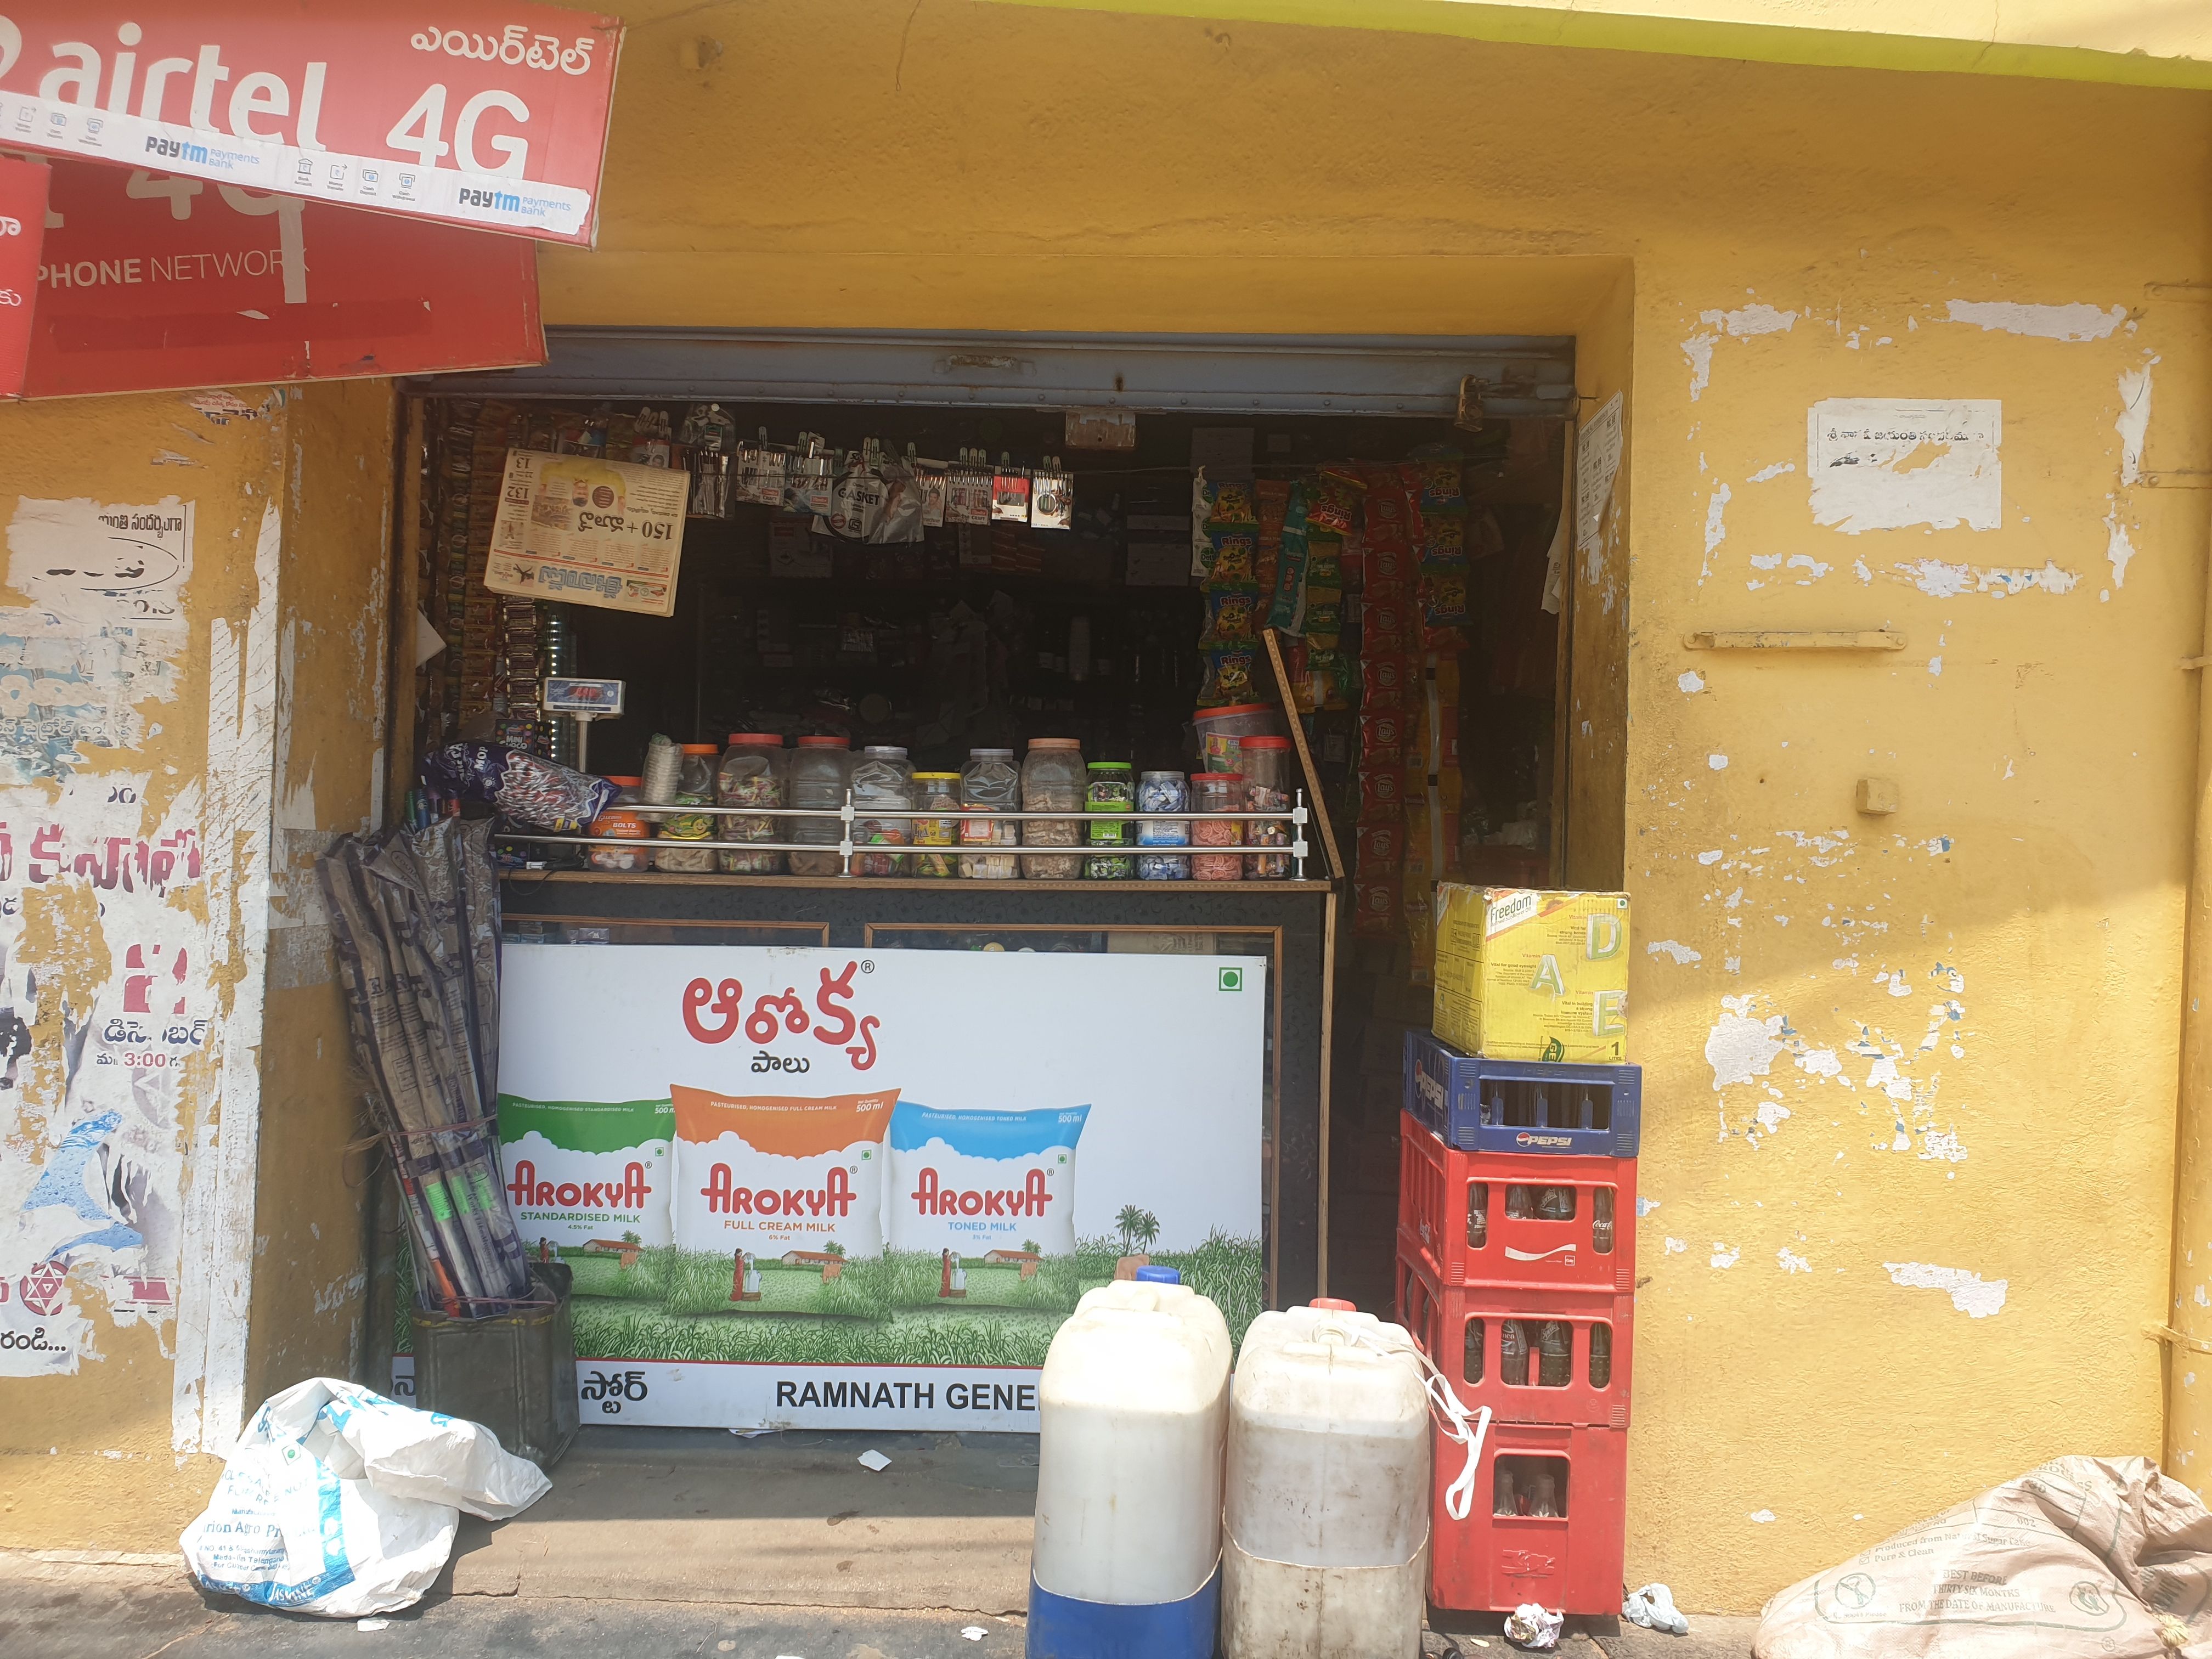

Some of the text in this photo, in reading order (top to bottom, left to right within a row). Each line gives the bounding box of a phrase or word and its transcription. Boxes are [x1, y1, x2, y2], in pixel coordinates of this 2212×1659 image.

[38, 22, 327, 152] airtel
[386, 83, 530, 179] 4G
[211, 149, 259, 164] Payments
[209, 159, 234, 170] Bank
[521, 206, 545, 217] Bank
[523, 197, 571, 211] Payments
[151, 248, 311, 281] NETWOR
[838, 487, 880, 506] GASKET
[642, 521, 674, 540] 150
[1221, 537, 1252, 546] Rings
[1221, 597, 1251, 607] Rings
[1221, 655, 1251, 665] Rings
[506, 735, 523, 743] MINI
[1489, 894, 1532, 923] Freedom
[1586, 913, 1622, 961] D
[1530, 953, 1565, 996] A
[682, 961, 881, 1071] ఆరోక్య
[1593, 989, 1627, 1036] E
[1611, 1041, 1620, 1056] 1
[124, 1052, 166, 1067] 3:00
[750, 1050, 810, 1074] పాలు
[654, 1106, 669, 1114] 500
[710, 1101, 749, 1111] PASTEURISED,
[856, 1101, 884, 1113] 500 ml
[1058, 1114, 1082, 1124] 500 ml
[1528, 1136, 1572, 1147] PEPSI
[507, 1160, 652, 1209] AROKYA
[700, 1163, 857, 1217] AROKYA
[911, 1167, 1053, 1217] AROKYA
[520, 1211, 641, 1224] STANDARDISED MILK
[723, 1220, 836, 1233] FULL CREAM MILK
[947, 1221, 1017, 1232] TONED MILK
[580, 1370, 648, 1414] స్టోర్
[777, 1381, 1041, 1412] RAMNATH GENE
[204, 1520, 261, 1536] rion Agro
[1920, 1534, 1943, 1545] from
[1875, 1553, 1897, 1563] Pure
[1908, 1547, 1935, 1557] Clean
[1943, 1569, 2008, 1585] BEST BEFORE
[1933, 1584, 2020, 1598] THIRTY SIX MONTHS
[1899, 1600, 1926, 1613] FROM
[1928, 1599, 1945, 1610] THE
[1945, 1599, 1970, 1610] DATE
[1985, 1601, 2056, 1613] MANUFACTURE
